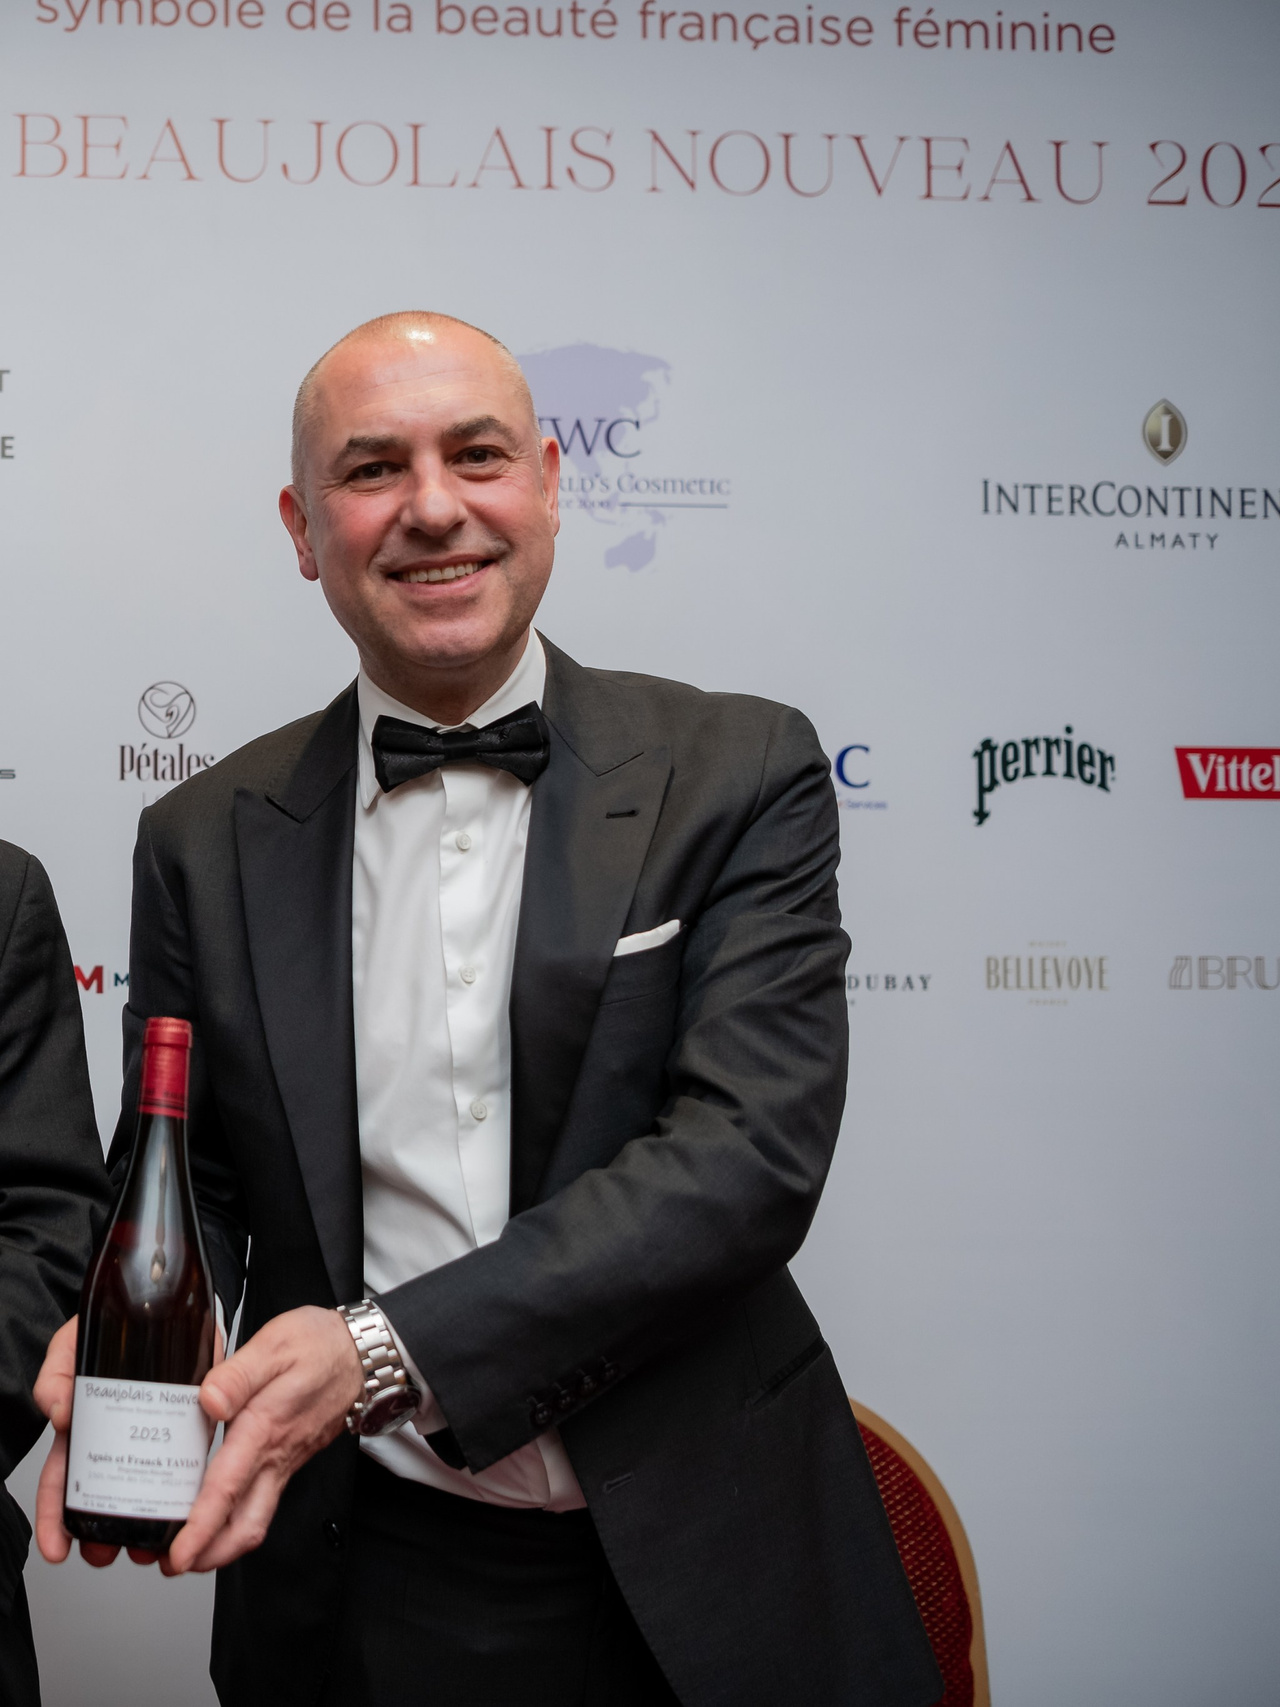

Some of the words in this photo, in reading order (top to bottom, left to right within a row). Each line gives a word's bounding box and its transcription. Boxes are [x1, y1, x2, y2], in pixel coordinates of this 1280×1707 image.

[35, 0, 265, 32] symbole
[286, 0, 351, 32] de
[373, 0, 414, 33] la
[436, 0, 618, 39] beauté
[640, 2, 875, 50] française
[894, 7, 1116, 54] féminine
[12, 112, 616, 193] BEAUJOLAIS
[645, 128, 1112, 205] NOUVEAU
[538, 416, 641, 459] WC
[617, 472, 731, 495] Cosmetic
[1115, 531, 1219, 550] ALMATY
[972, 723, 1116, 827] perrier
[1185, 752, 1280, 793] Vittel
[847, 973, 933, 992] DUBAY
[985, 955, 1110, 991] BELLEVOYE
[84, 1382, 154, 1404] Beaujolais
[159, 1391, 200, 1406] Nouve
[129, 1424, 172, 1443] 2023
[127, 1453, 163, 1467] Franck
